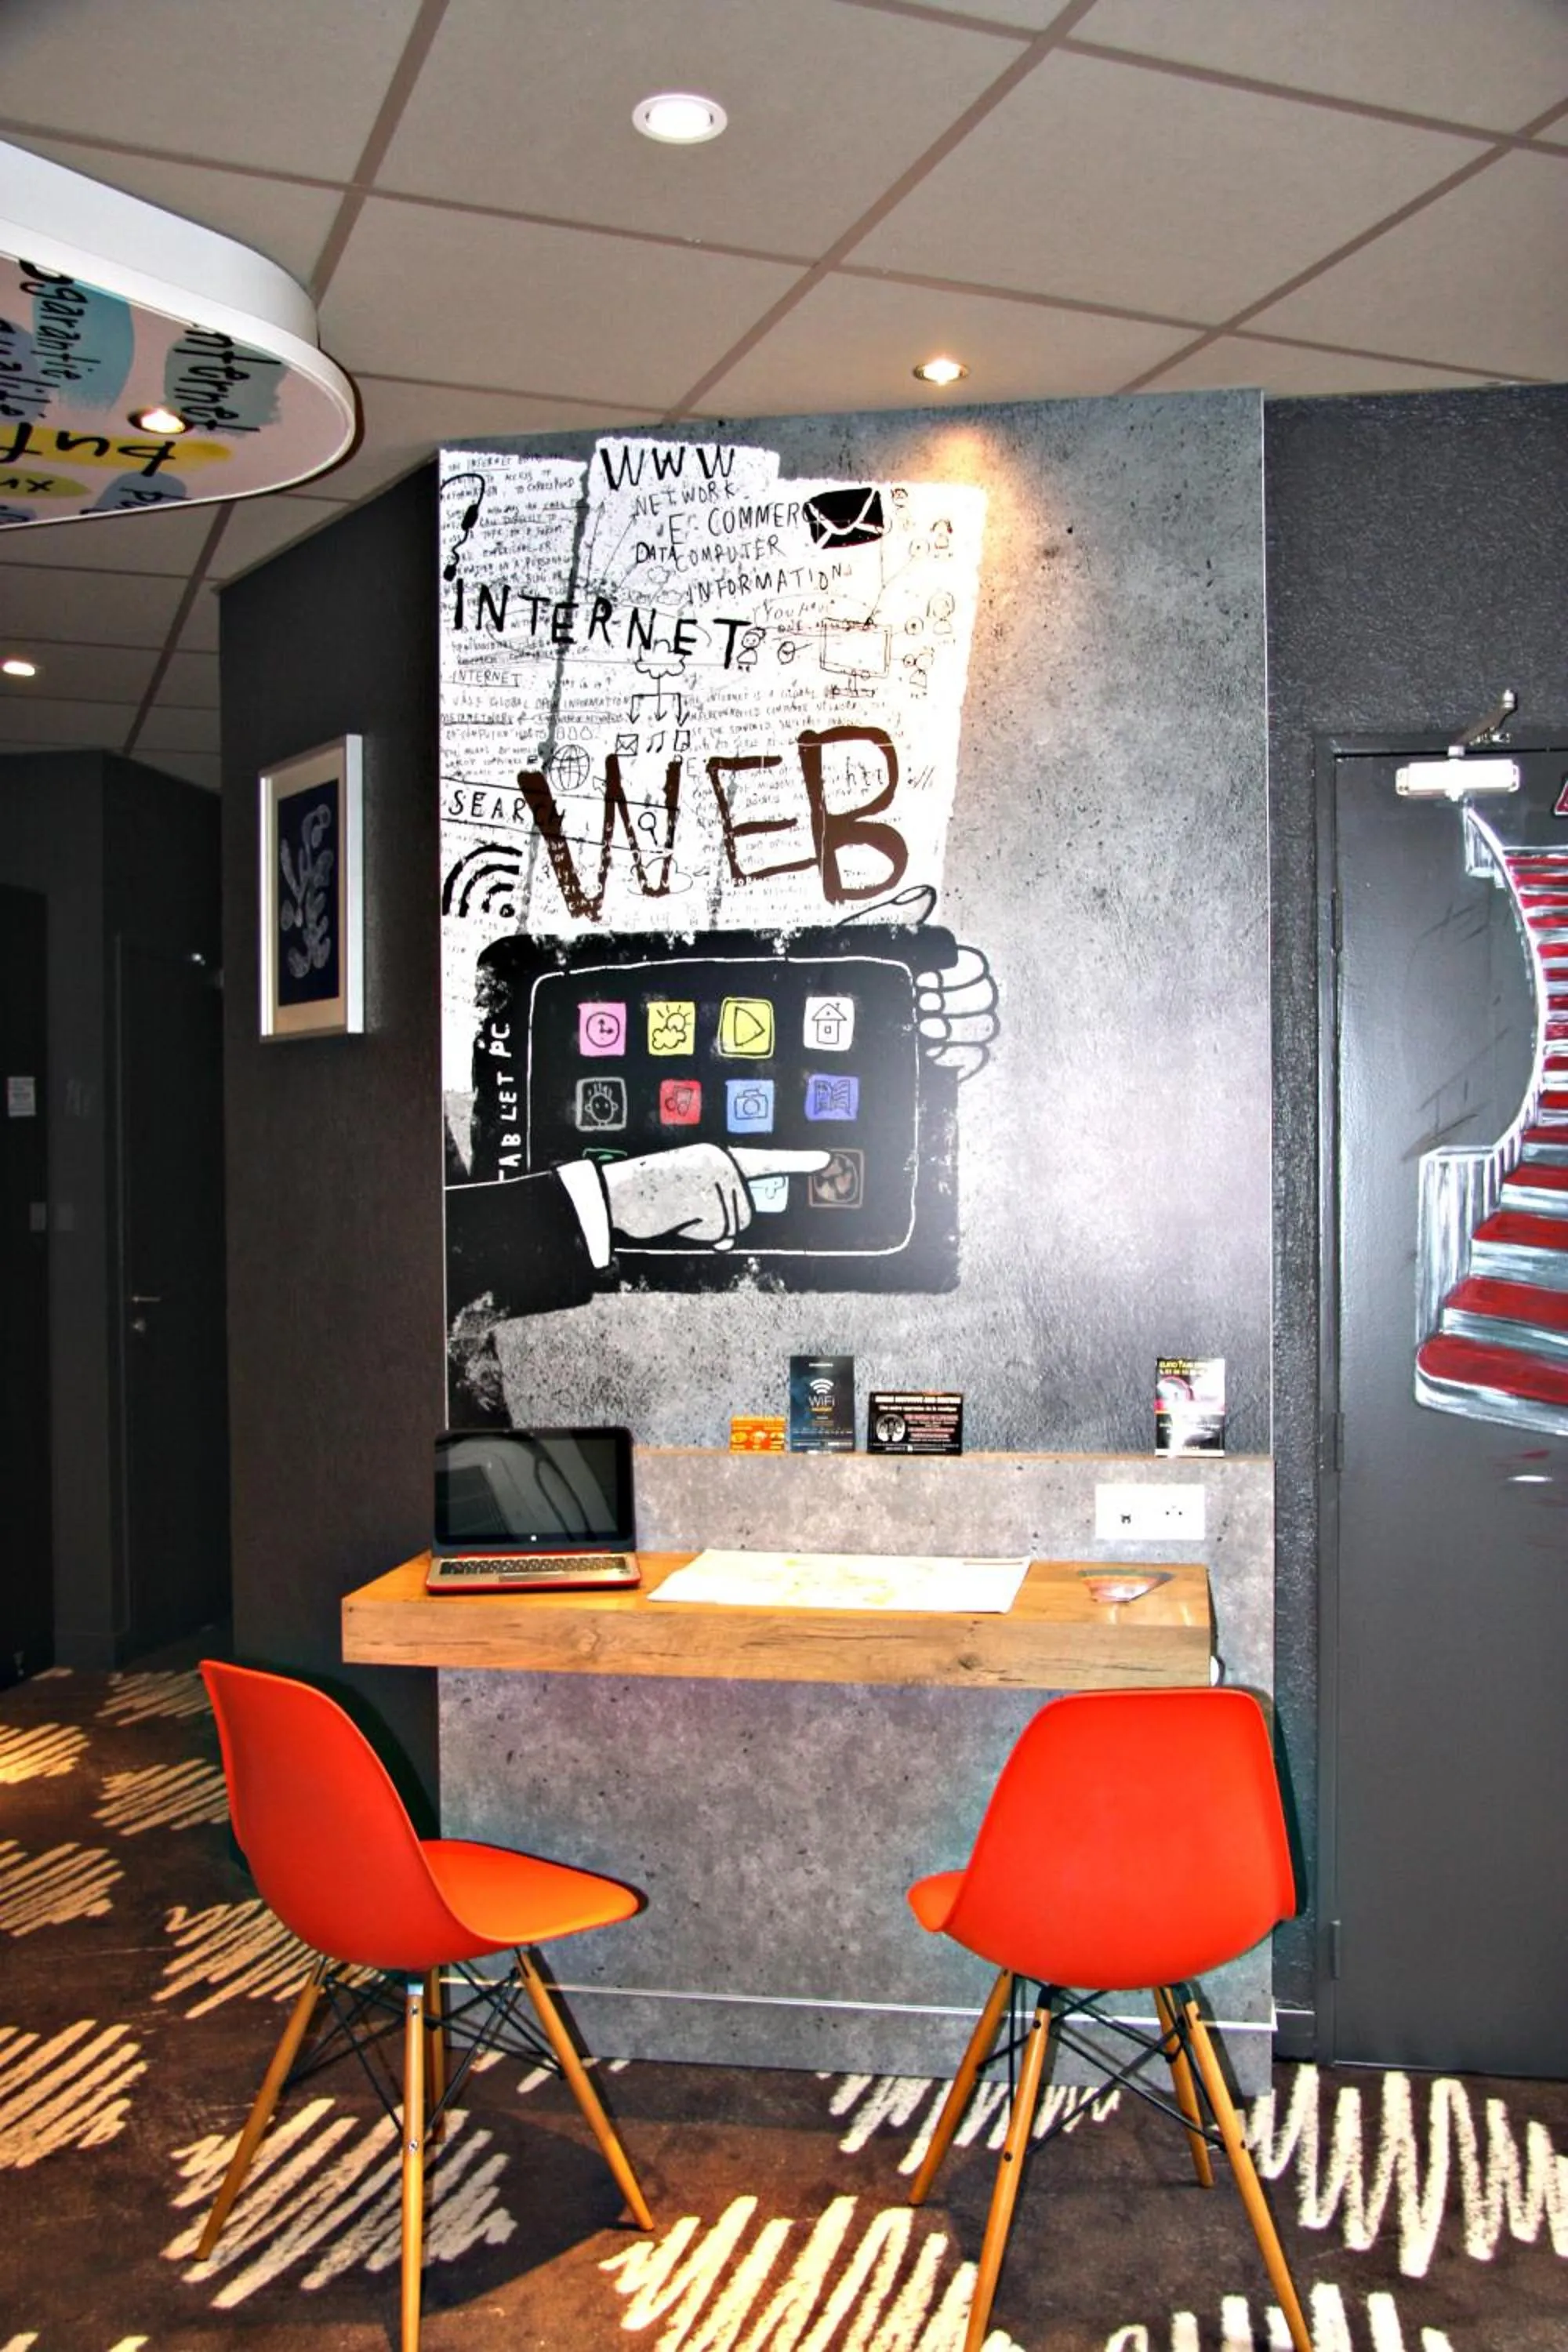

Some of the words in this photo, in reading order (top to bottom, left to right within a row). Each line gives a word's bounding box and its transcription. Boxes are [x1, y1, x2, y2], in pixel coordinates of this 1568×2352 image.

[172, 328, 282, 433] nternet
[631, 480, 736, 517] NETWORK
[636, 541, 677, 564] DATA
[674, 534, 787, 572] COMPUTER
[687, 562, 842, 604] INFORMATION
[453, 577, 753, 670] INTERNET
[452, 669, 522, 688] INTERNET
[517, 725, 909, 923] WEB
